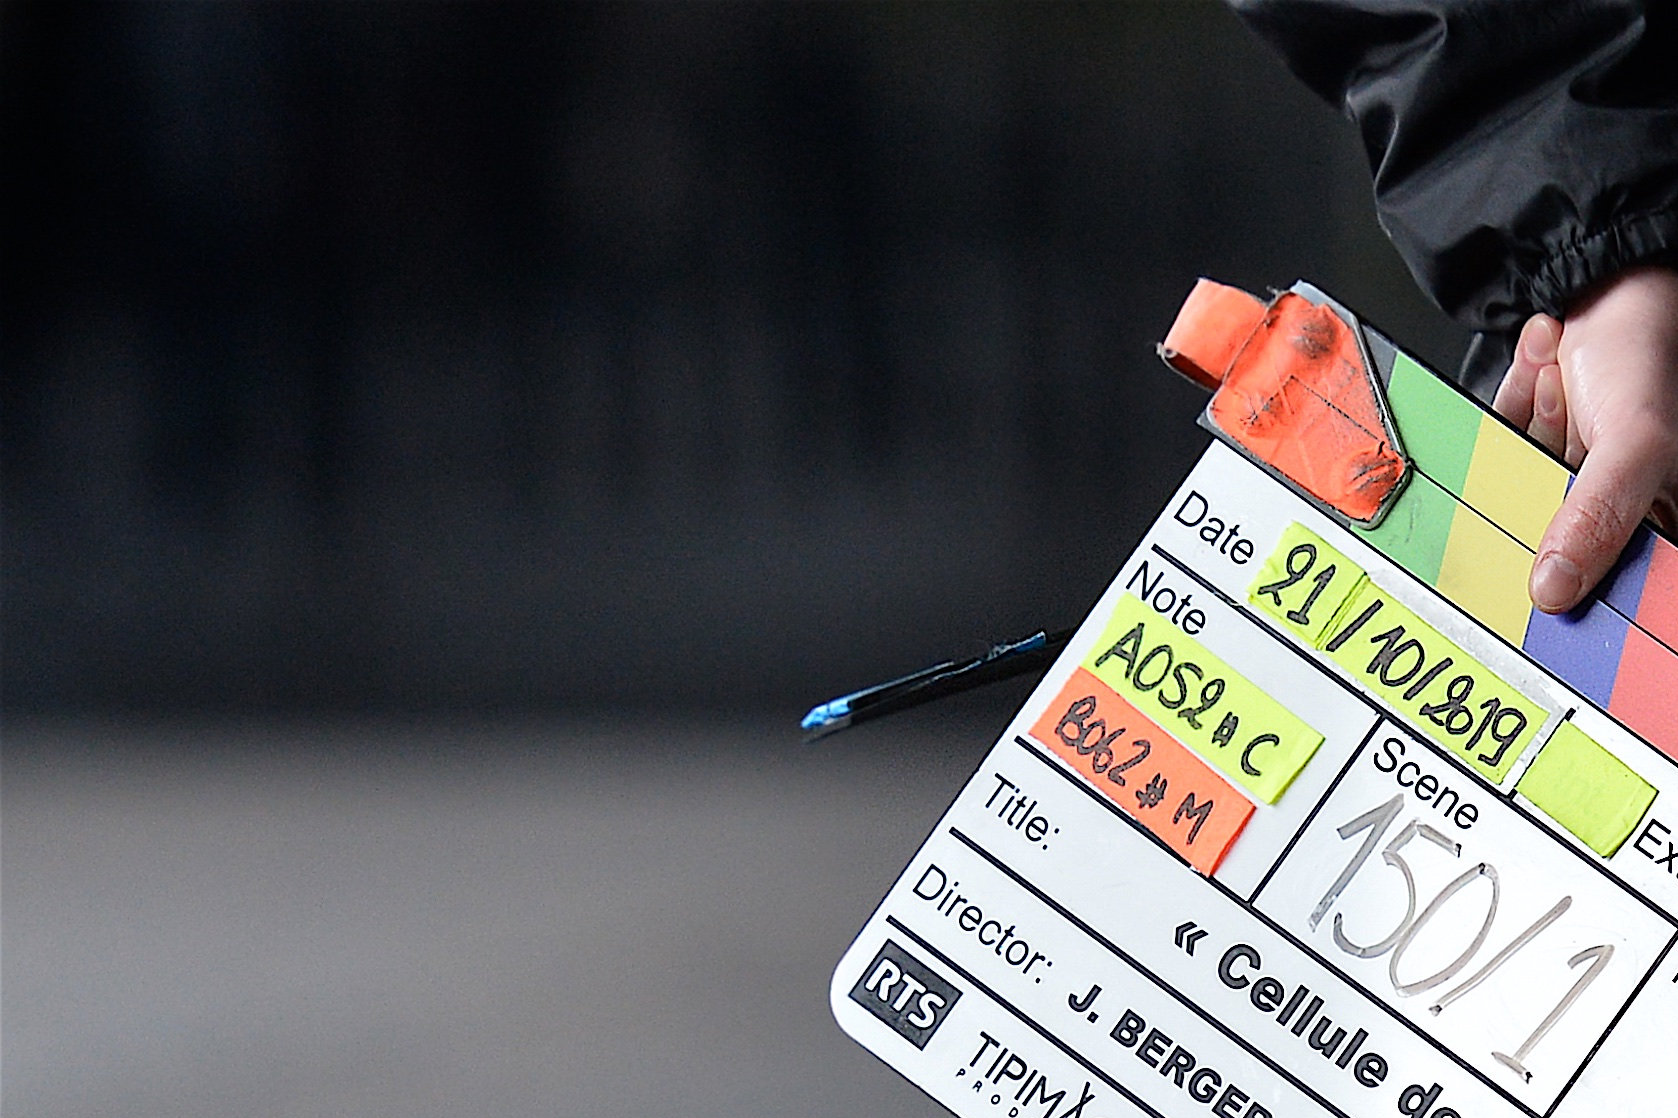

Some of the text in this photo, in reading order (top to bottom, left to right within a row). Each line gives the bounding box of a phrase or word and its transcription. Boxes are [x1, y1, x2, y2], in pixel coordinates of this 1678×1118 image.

[1173, 490, 1255, 566] Date
[1125, 560, 1207, 635] Note
[1373, 737, 1479, 830] Scene
[912, 863, 1054, 984] Director:
[1069, 984, 1103, 1024] J.
[985, 773, 1060, 850] Title:
[1217, 943, 1389, 1088] Cellule
[1309, 793, 1615, 1084] 150/1
[864, 958, 947, 1030] RTS
